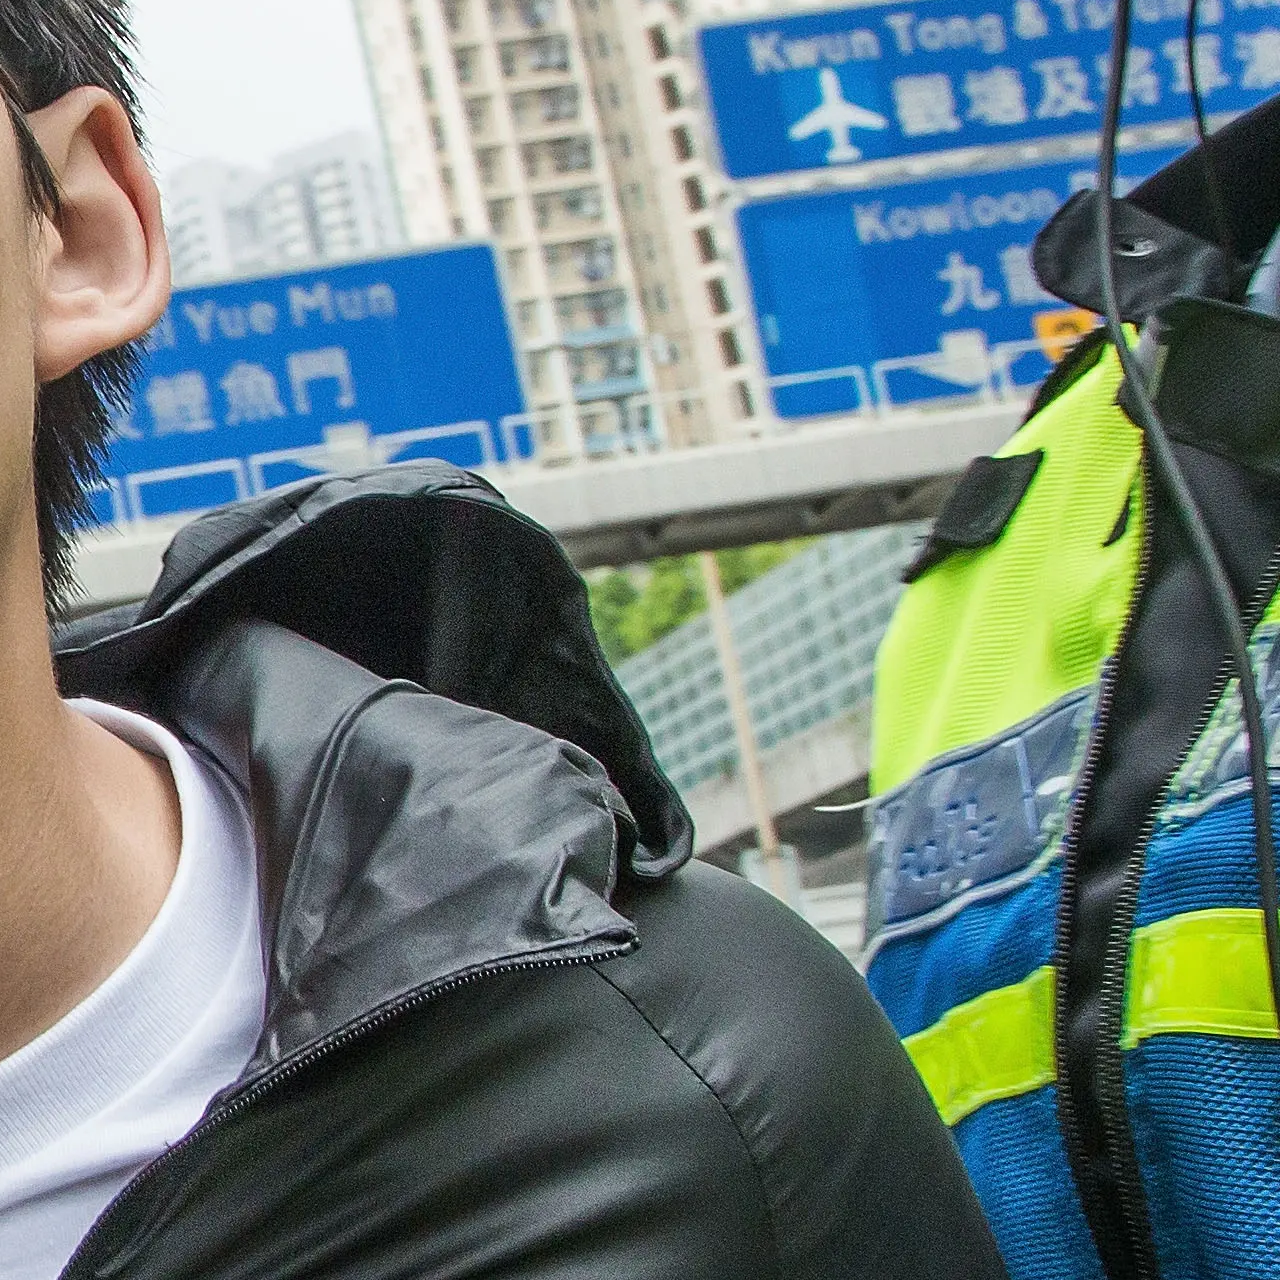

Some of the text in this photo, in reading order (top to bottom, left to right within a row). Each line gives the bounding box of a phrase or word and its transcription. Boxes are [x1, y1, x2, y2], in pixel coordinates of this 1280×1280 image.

[747, 27, 881, 75] Kwun
[885, 11, 1007, 55] Tong
[184, 299, 277, 344] Yue
[288, 281, 395, 327] Mun
